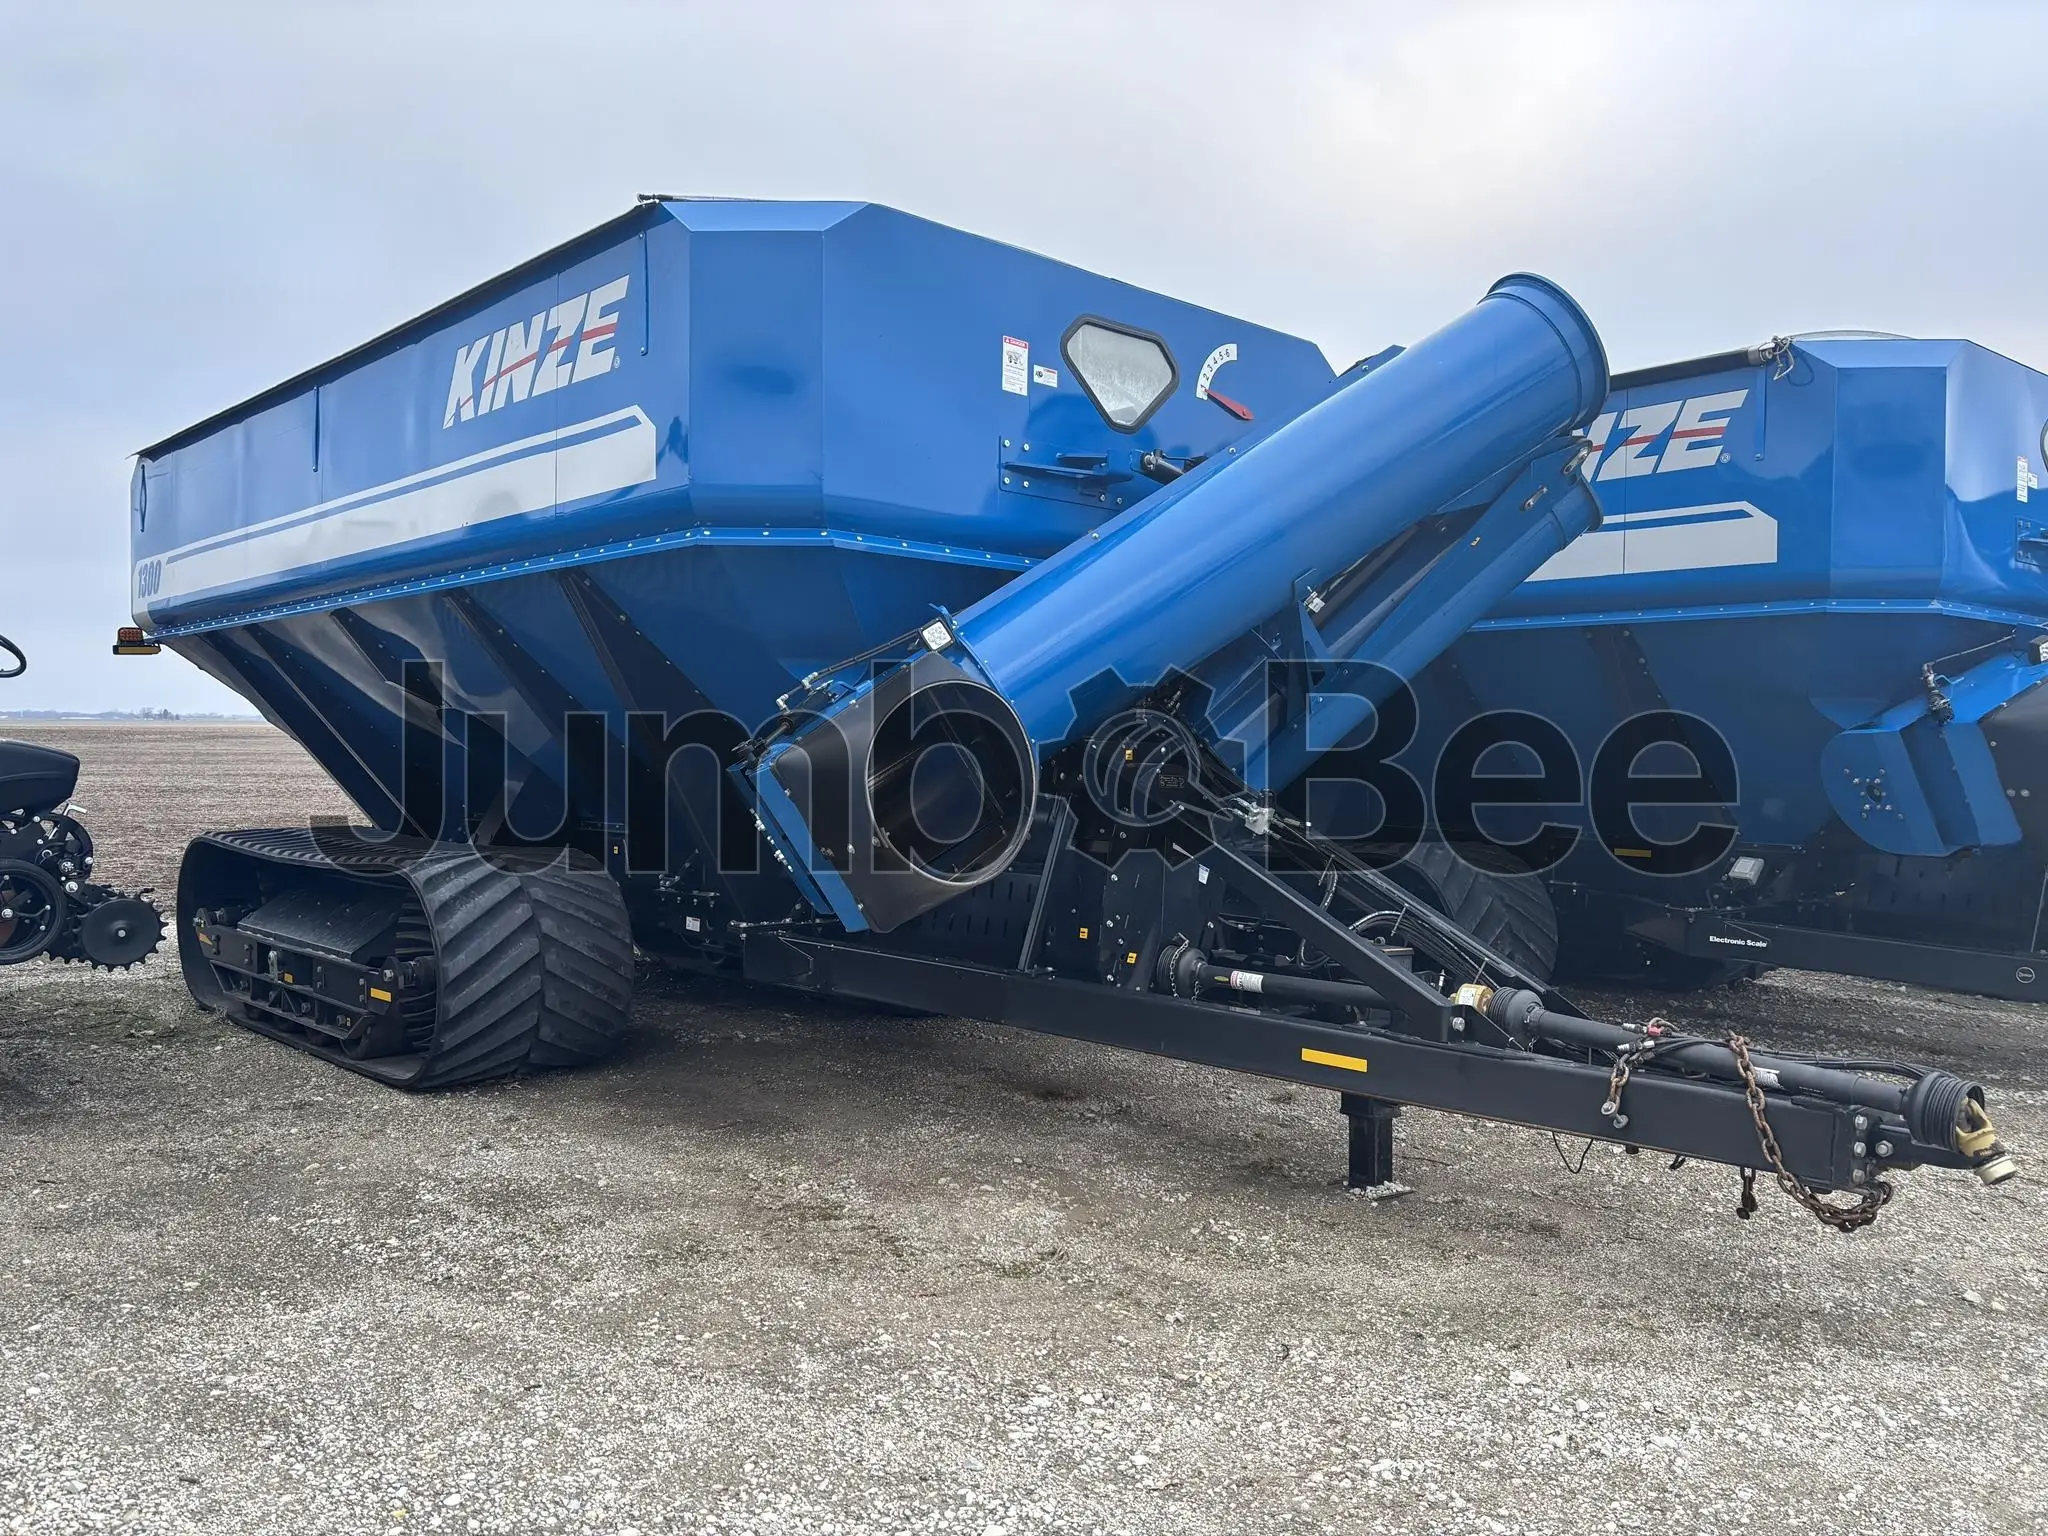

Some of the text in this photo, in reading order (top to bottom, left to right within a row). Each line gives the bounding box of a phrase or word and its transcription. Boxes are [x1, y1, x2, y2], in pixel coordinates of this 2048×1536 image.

[443, 274, 630, 429] KINZE
[137, 560, 162, 599] 1300
[1709, 935, 1767, 948] Electronic Scale
